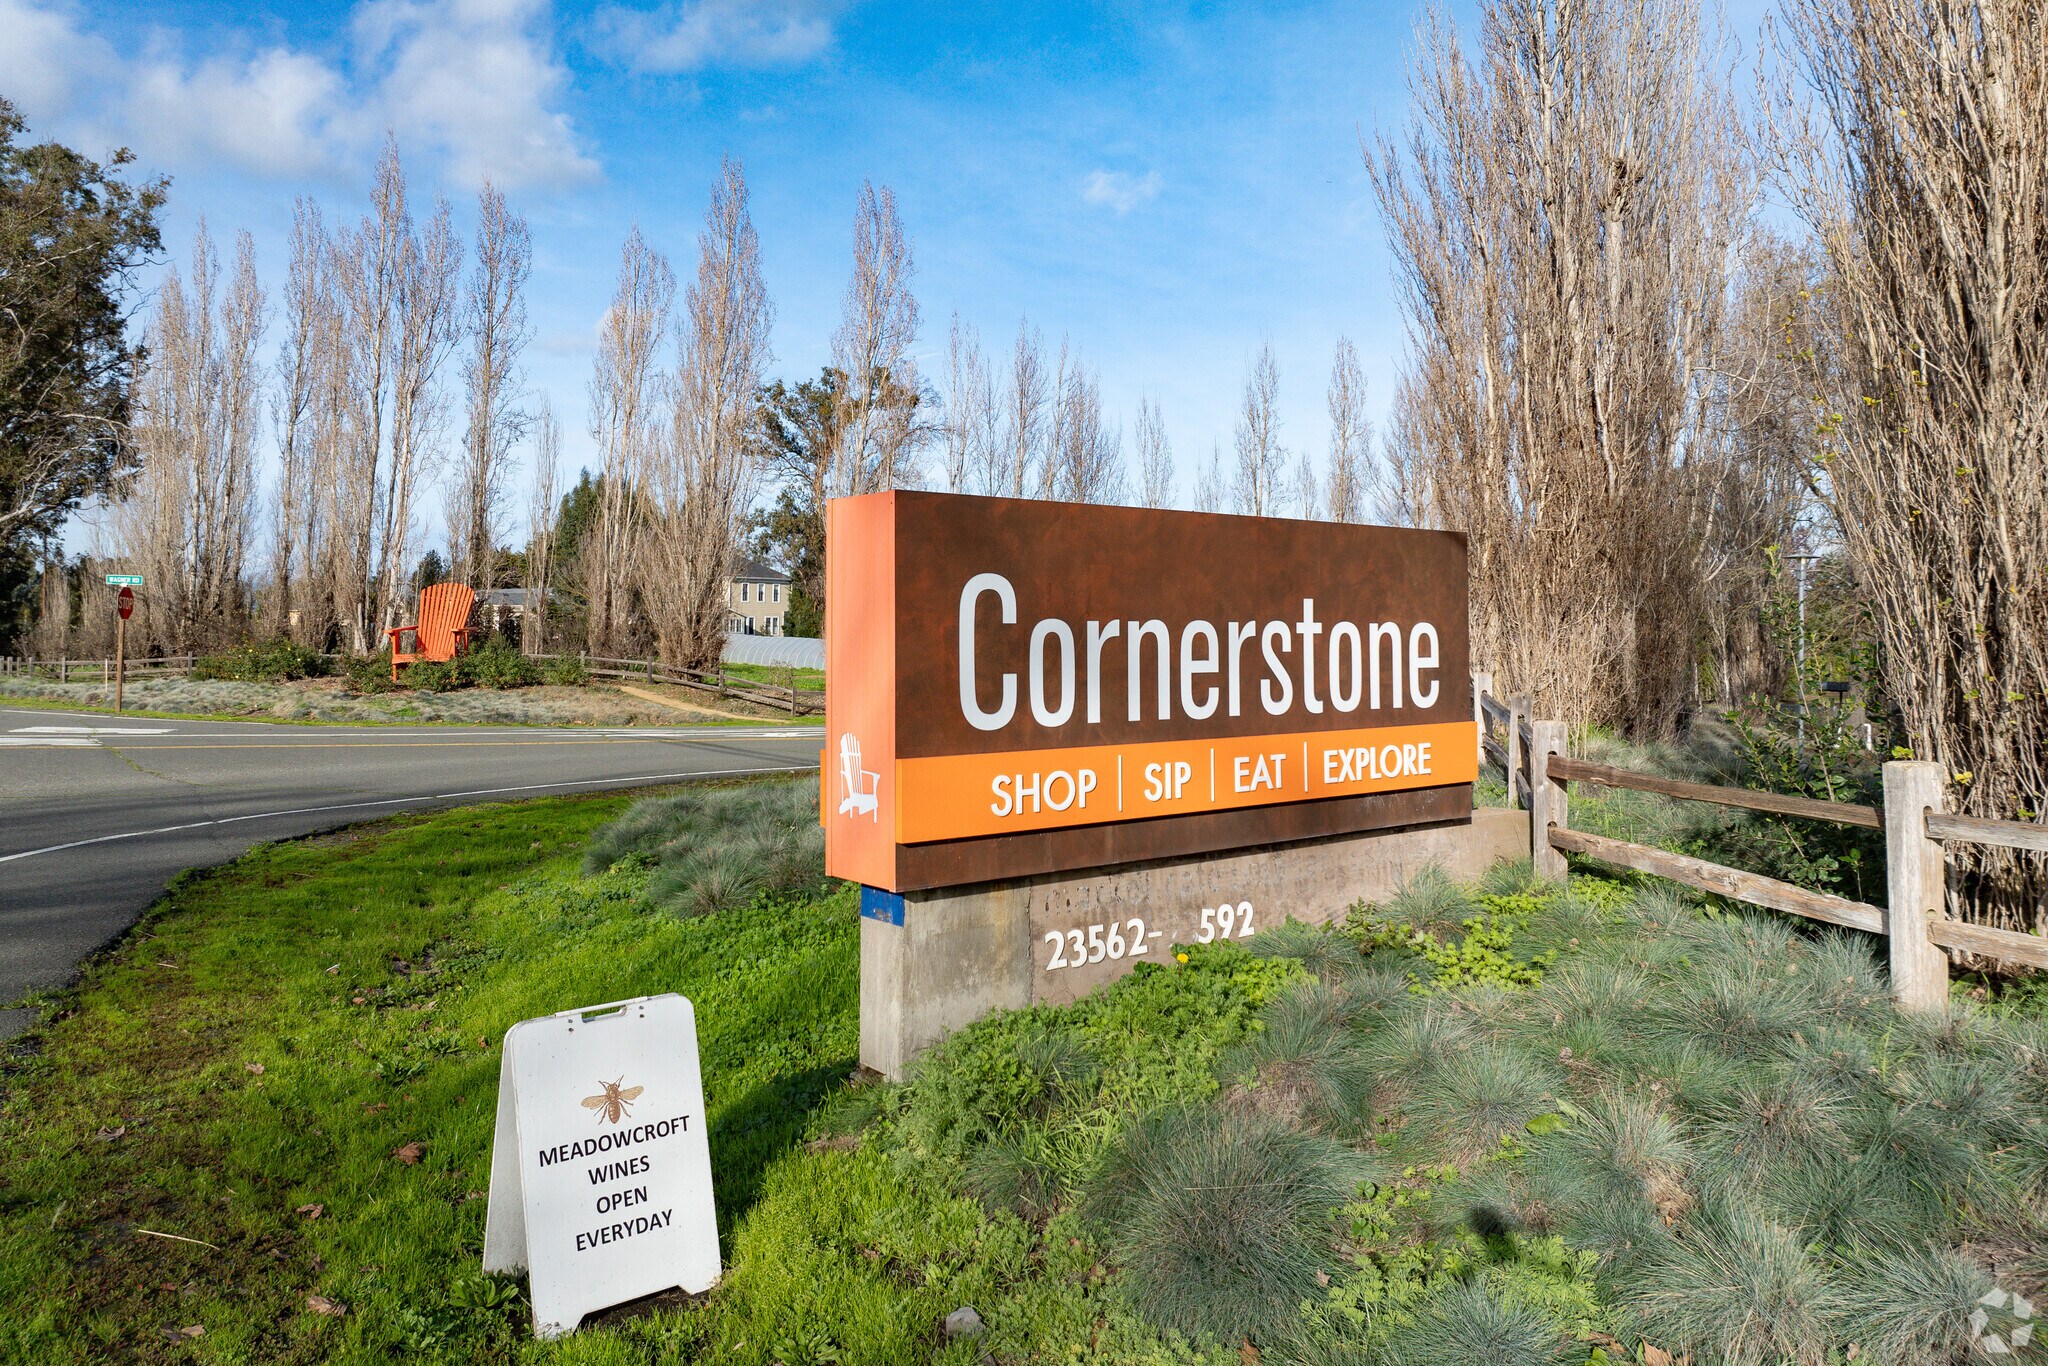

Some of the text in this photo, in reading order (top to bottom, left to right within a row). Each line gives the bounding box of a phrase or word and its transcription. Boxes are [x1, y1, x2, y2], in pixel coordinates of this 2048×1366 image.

[118, 597, 133, 609] STOP
[958, 572, 1440, 731] Cornerstone
[990, 743, 1431, 817] SHOP SIP EAT EXPLORE
[1044, 901, 1255, 971] 23562- 592
[539, 1115, 690, 1167] MEADOWCROFT
[588, 1155, 650, 1185] WINES
[596, 1186, 648, 1214] OPEN
[576, 1209, 673, 1251] EVERYDAY
